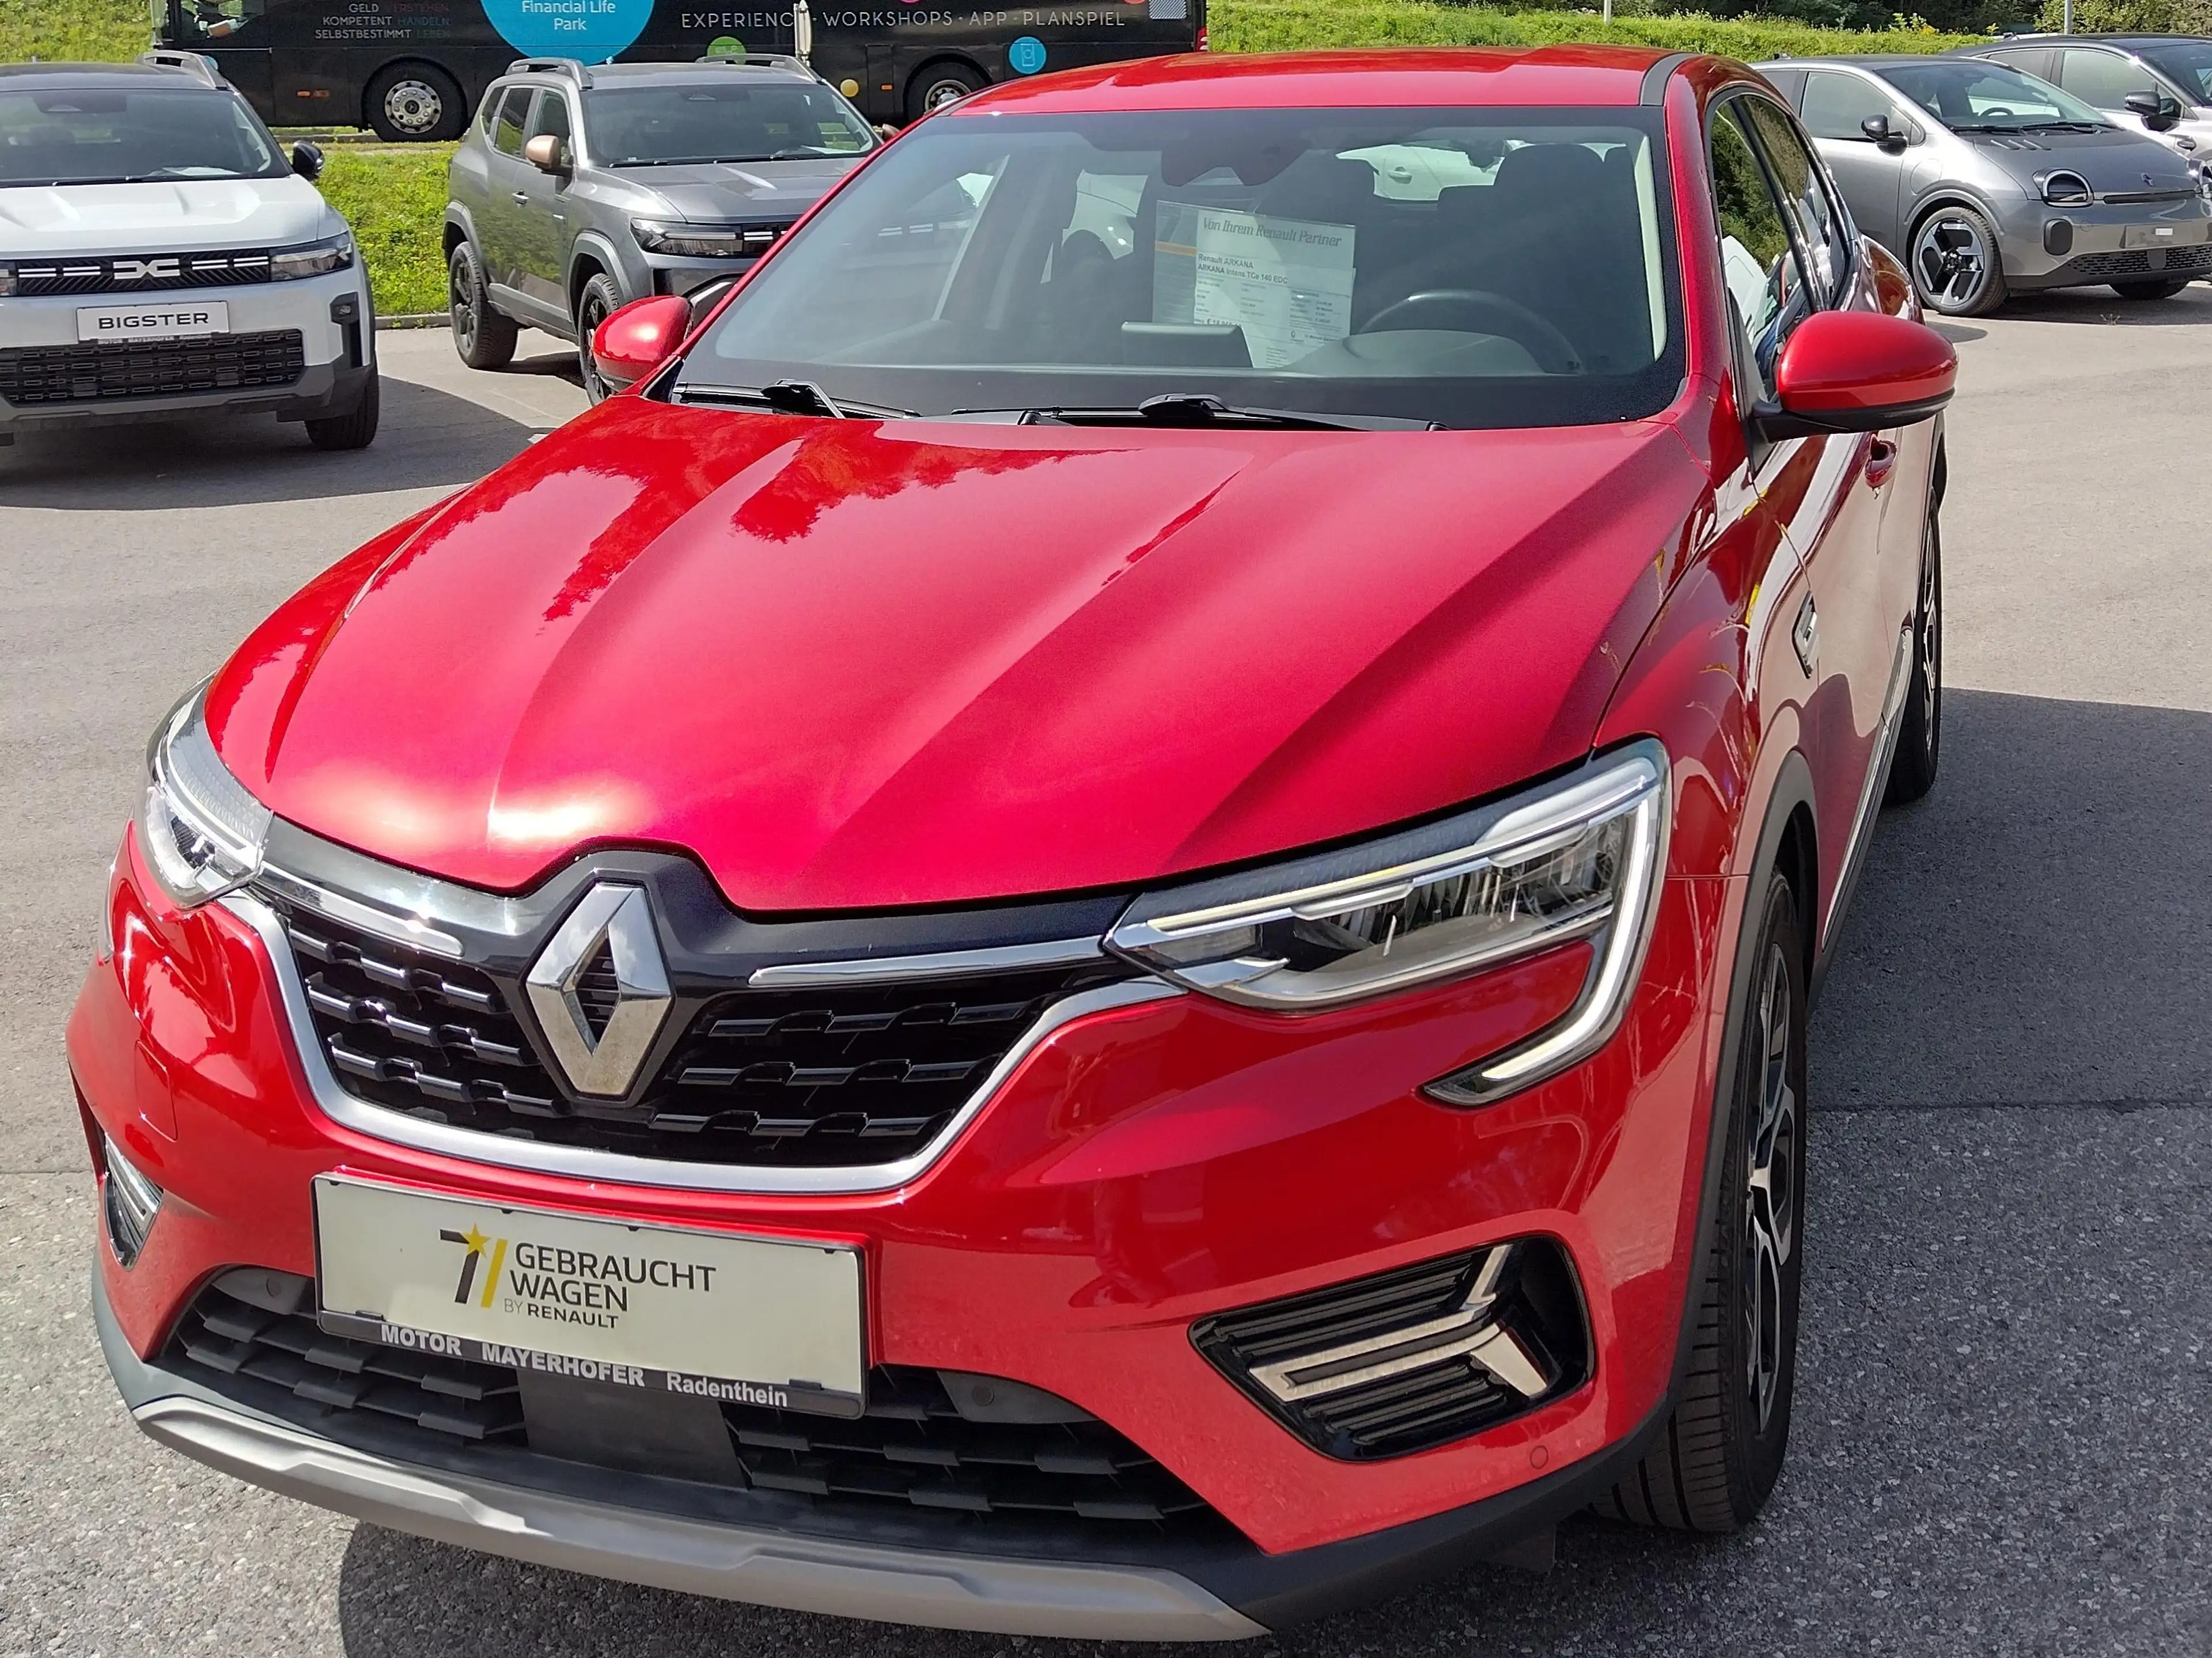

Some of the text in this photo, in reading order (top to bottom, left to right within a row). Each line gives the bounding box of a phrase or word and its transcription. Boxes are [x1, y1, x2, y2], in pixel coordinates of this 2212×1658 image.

[349, 3, 380, 13] GELD
[522, 0, 616, 13] Financial Life
[323, 16, 392, 26] KOMPETENT
[554, 17, 587, 31] Park
[681, 11, 1126, 28] EXPERIENC WORKSHOPS APP PLANSPIEL
[315, 29, 411, 39] SELBSTBESTIMMT
[1203, 217, 1342, 246] Von Ihrem Renault Partner
[1198, 253, 1253, 269] Renault ARKANA
[1198, 263, 1225, 274] ARKANA
[1261, 274, 1272, 282] 140
[1274, 275, 1288, 284] EDC
[99, 313, 209, 329] BIGSTER
[515, 1242, 717, 1292] GEBRAUCHT
[509, 1269, 628, 1312] WAGEN
[504, 1297, 619, 1329] BY RENAULT
[381, 1324, 787, 1407] MOTOR MAYERHOFER Radenthein
